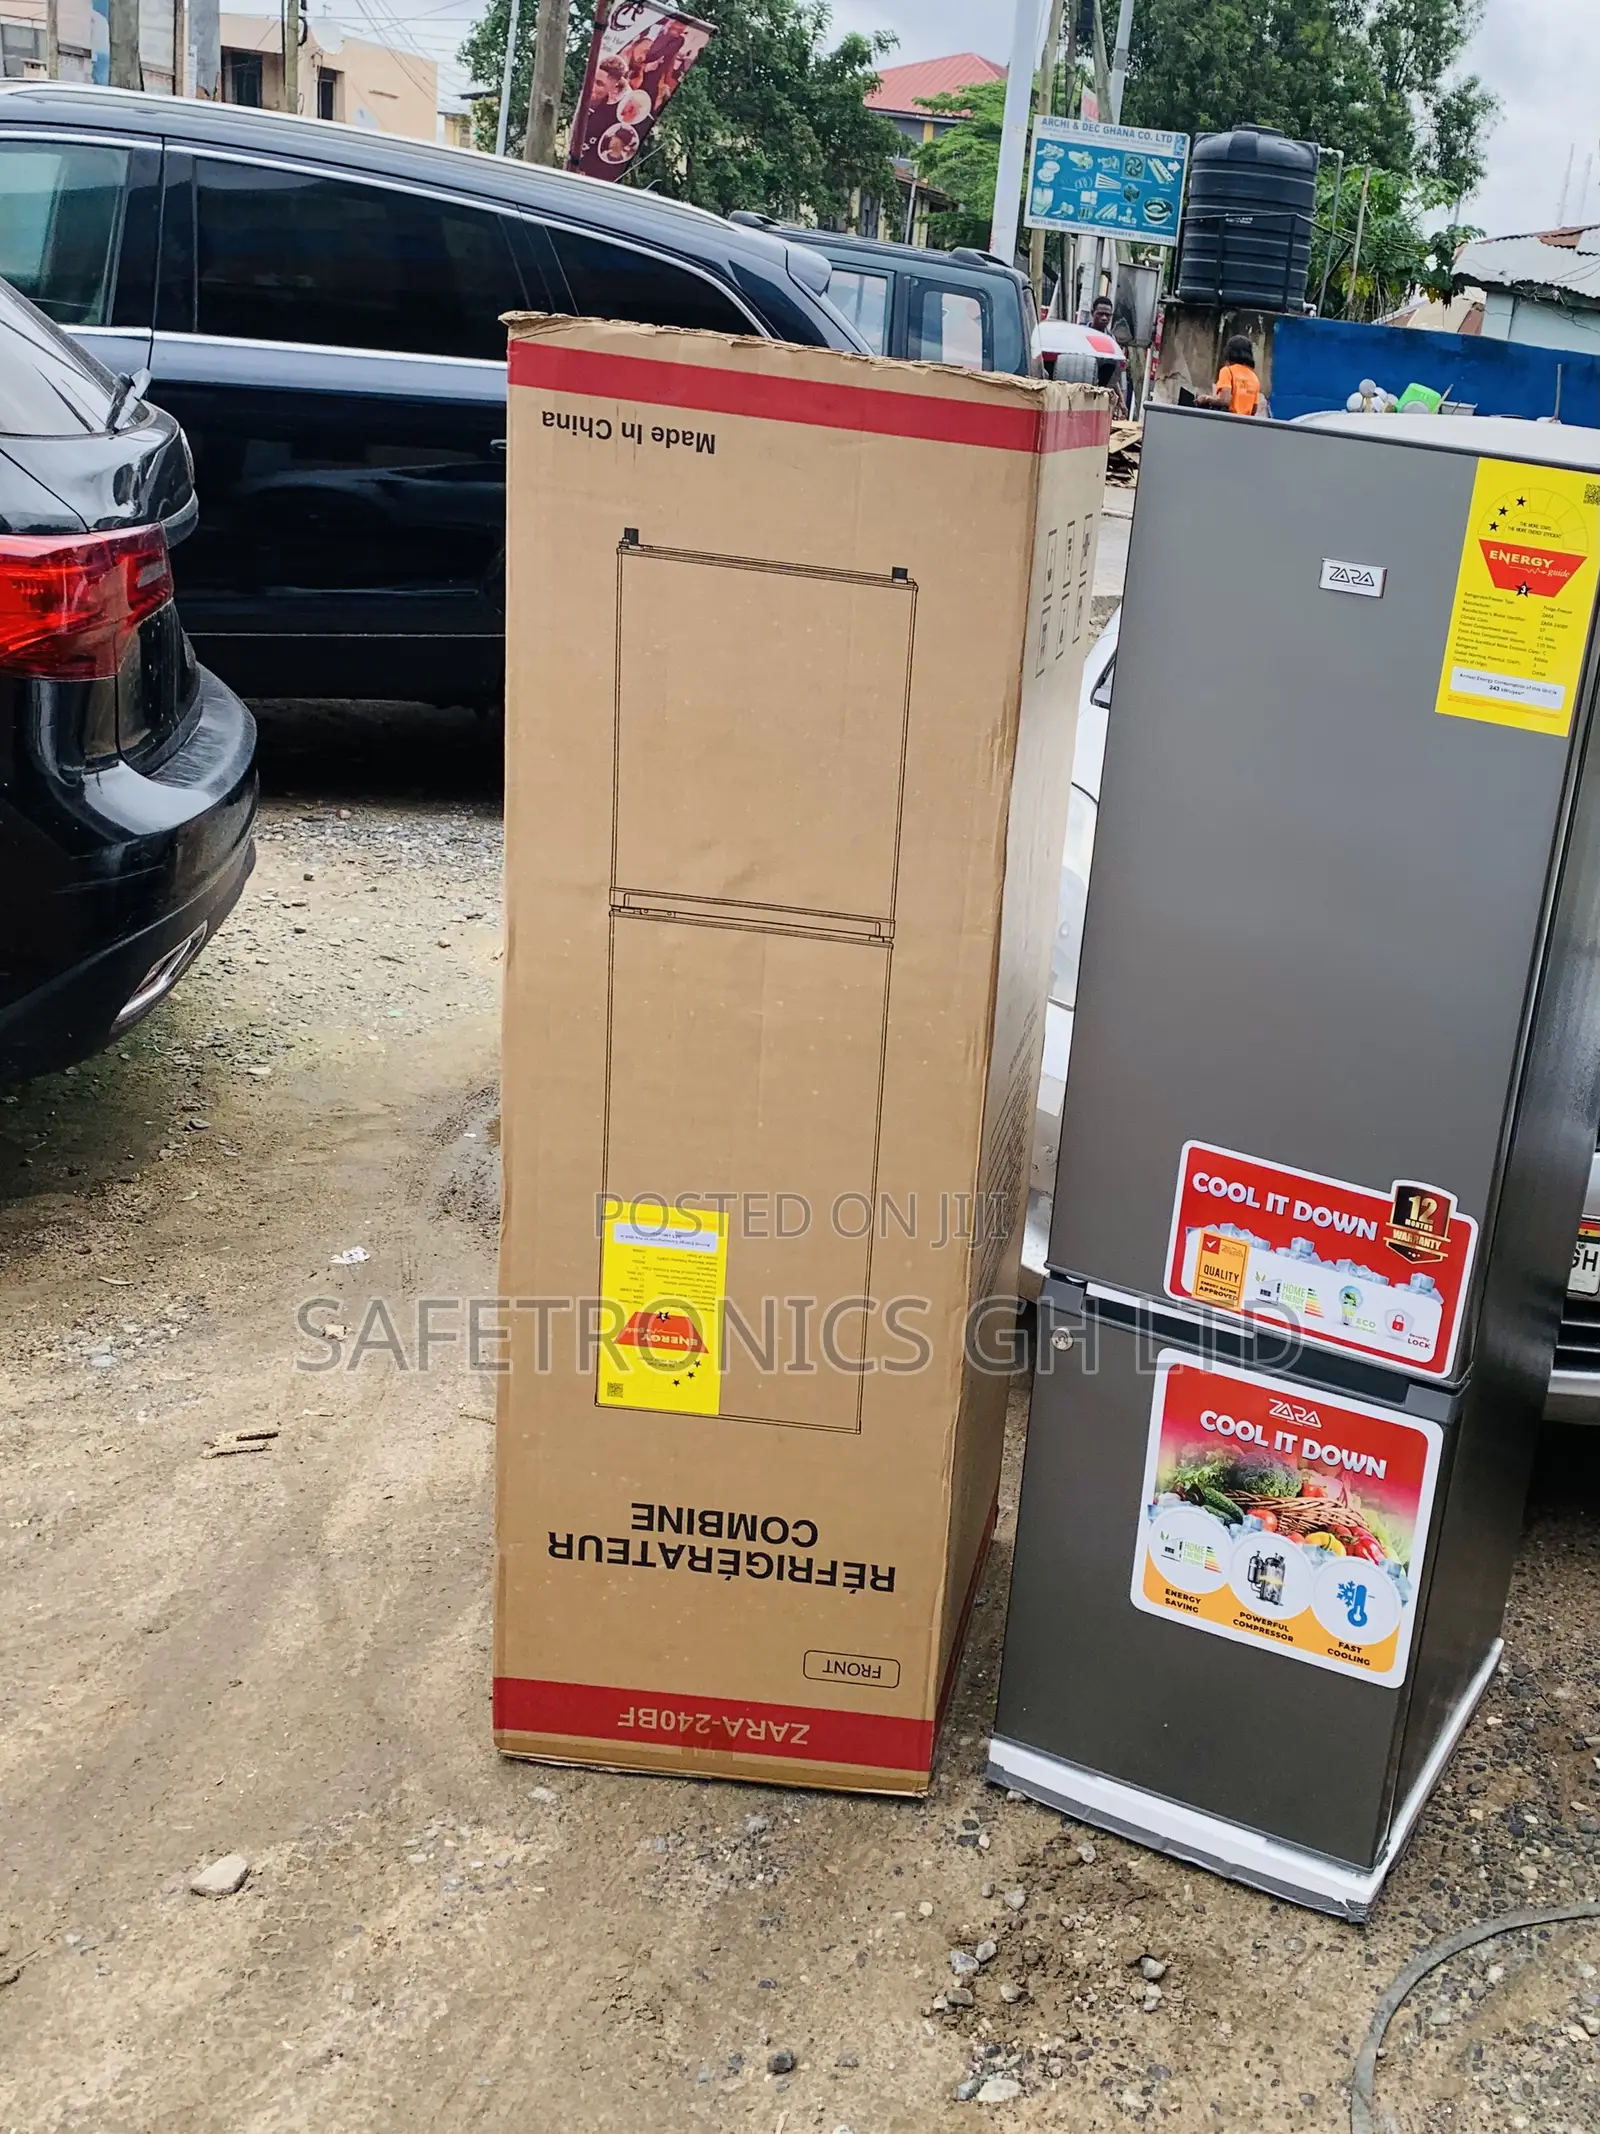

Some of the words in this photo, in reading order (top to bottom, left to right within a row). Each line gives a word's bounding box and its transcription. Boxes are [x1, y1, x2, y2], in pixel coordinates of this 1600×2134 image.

[1042, 118, 1069, 129] ARCHI
[1083, 124, 1100, 132] DEC
[1103, 128, 1135, 137] GHANA
[1138, 131, 1152, 140] CO.
[1156, 134, 1173, 143] LTD
[542, 411, 612, 440] China
[621, 422, 642, 444] In
[651, 426, 715, 454] Made
[1489, 548, 1554, 569] ENERGY
[1330, 566, 1374, 586] ZARA
[1547, 567, 1570, 578] guide
[1192, 1172, 1260, 1208] COOL
[1266, 1192, 1289, 1215] IT
[1293, 1200, 1378, 1241] DOWN
[1409, 1195, 1437, 1224] 12
[1393, 1229, 1442, 1250] WARRANTY
[1204, 1265, 1239, 1283] QUALITY
[1199, 1286, 1238, 1300] APPROVED
[1283, 1283, 1306, 1297] HOME
[1356, 1318, 1376, 1328] ECO
[640, 1331, 697, 1347] ENERGY
[1407, 1339, 1431, 1349] LOCK
[1269, 1398, 1322, 1429] ZARA
[1199, 1410, 1268, 1447] COOL
[1274, 1430, 1298, 1454] IT
[1302, 1438, 1387, 1479] DOWN
[631, 1502, 819, 1548] COMBINE
[547, 1531, 896, 1594] RÉFRIGÉRATEUR
[1165, 1588, 1201, 1604] ENERGY
[1165, 1597, 1199, 1613] SAVING
[1233, 1618, 1294, 1643] COMPRESSOR
[1239, 1611, 1289, 1632] POWERFUL
[1327, 1647, 1371, 1666] COOLING
[1338, 1641, 1362, 1654] FAST
[822, 1659, 881, 1679] FRONT
[618, 1707, 810, 1745] ZARA-240BF
